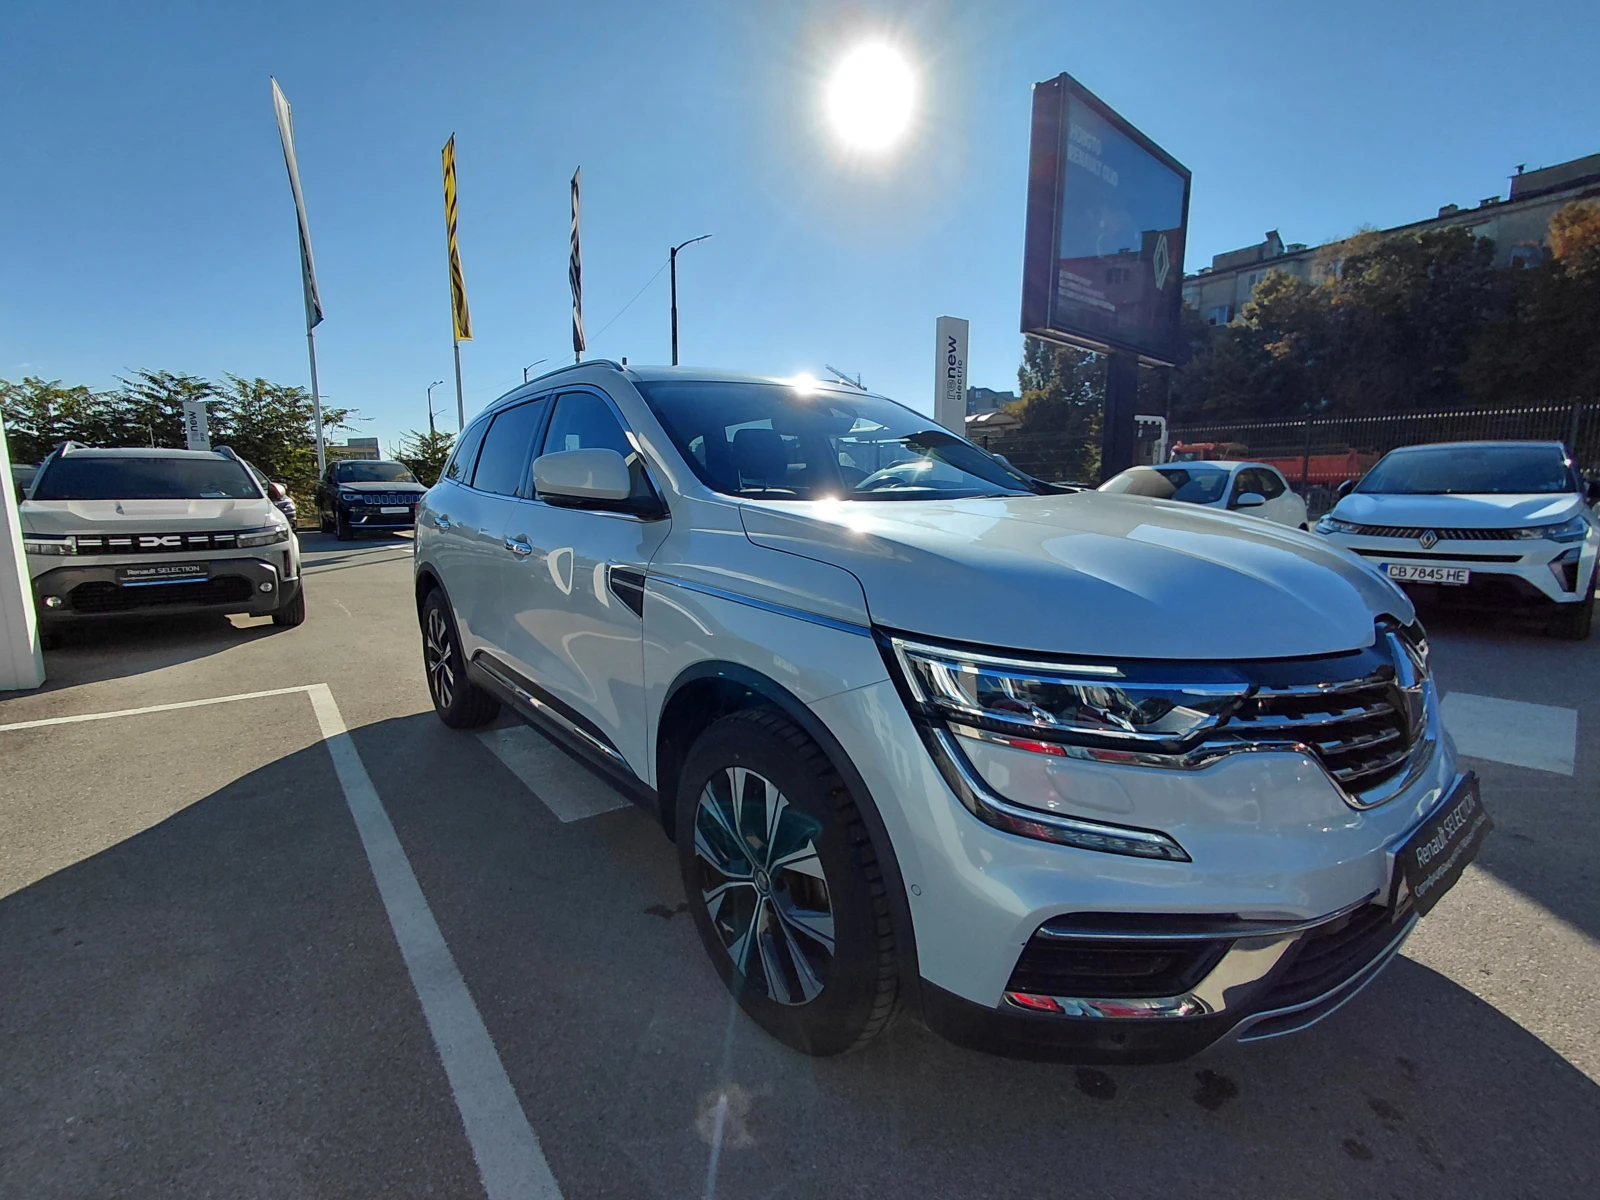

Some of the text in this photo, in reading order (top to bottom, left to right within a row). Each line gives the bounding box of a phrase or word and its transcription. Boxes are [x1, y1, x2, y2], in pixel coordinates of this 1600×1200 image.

[157, 565, 200, 574] SELECTION
[1389, 566, 1466, 582] CB 7845 HE
[1416, 826, 1448, 868] Renault
